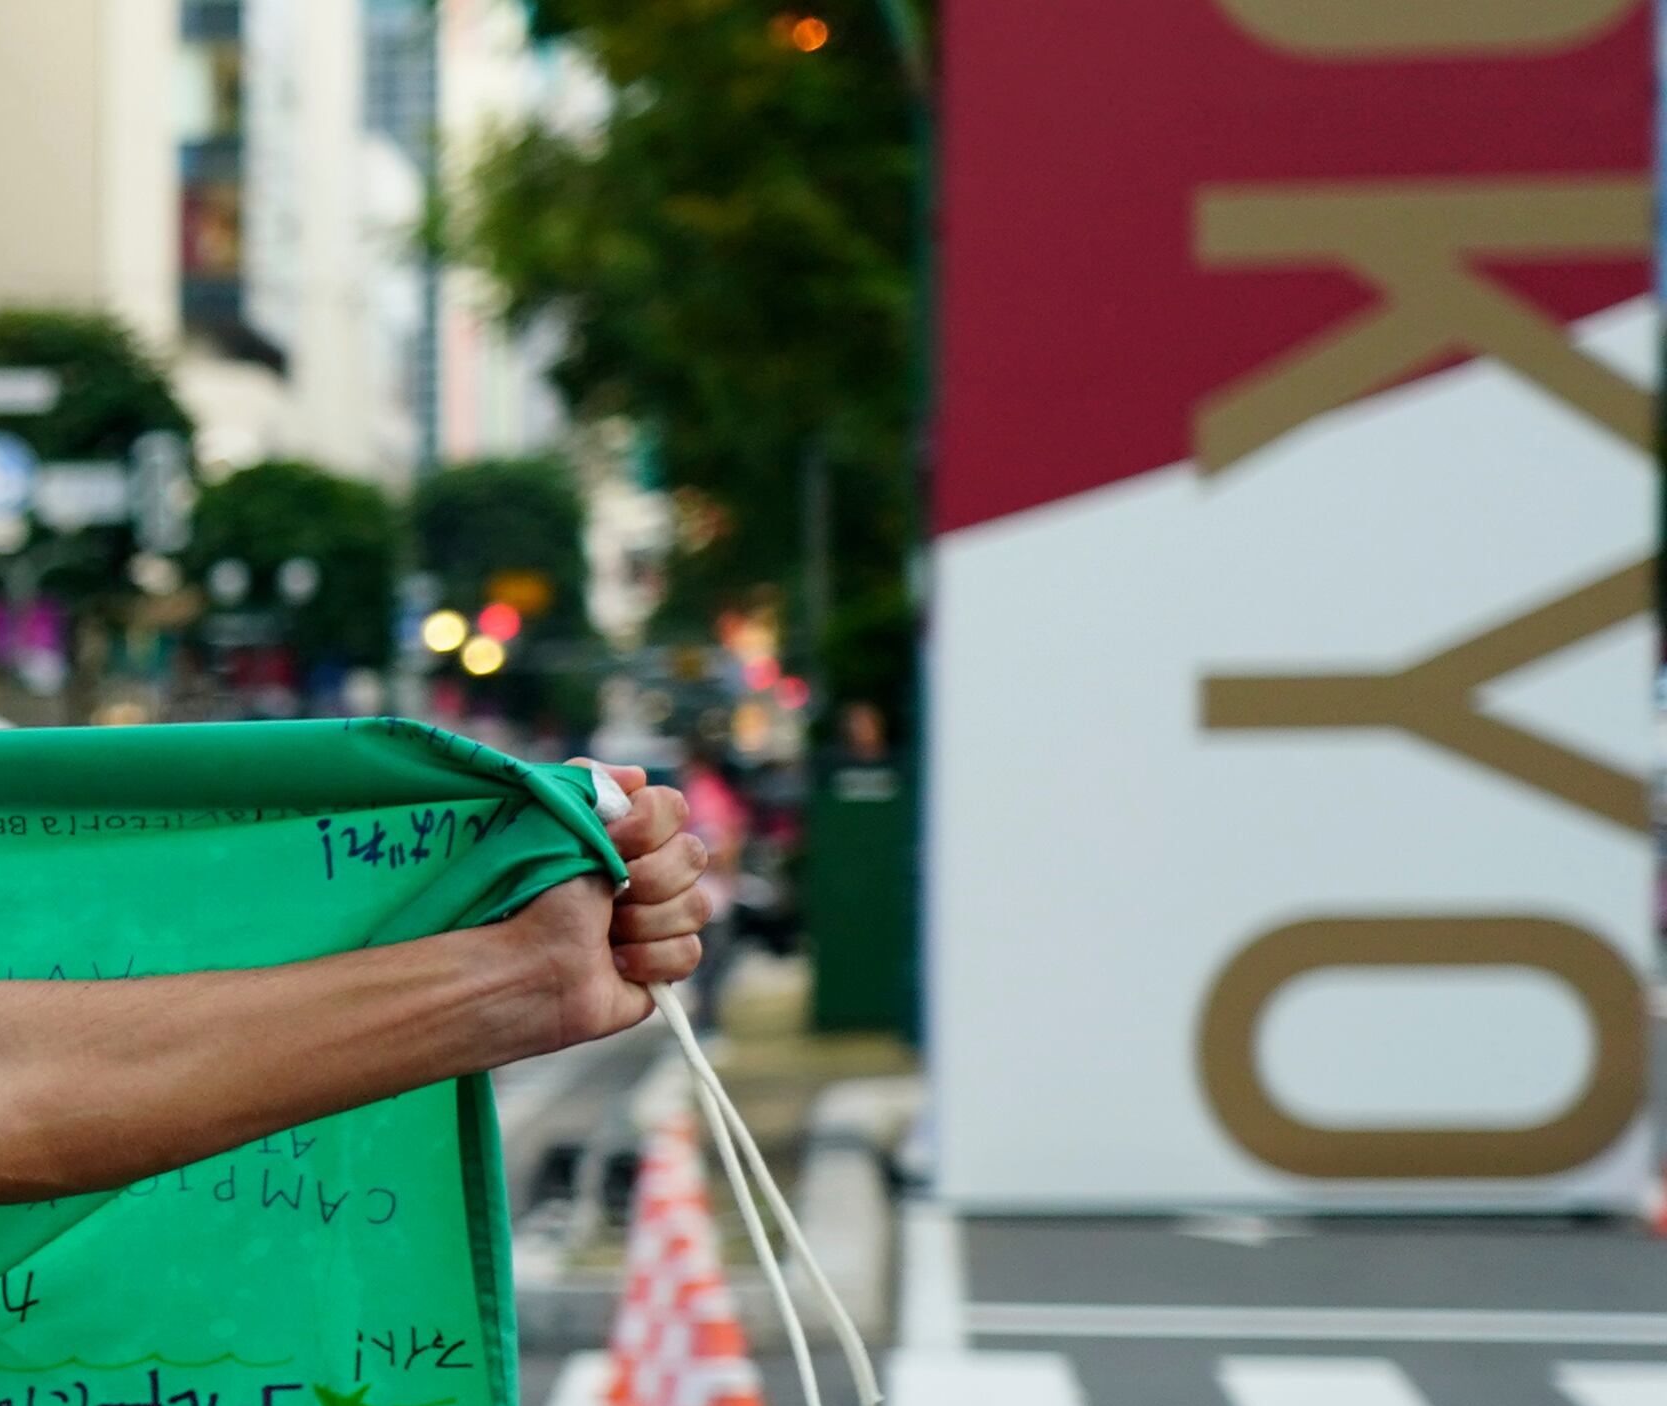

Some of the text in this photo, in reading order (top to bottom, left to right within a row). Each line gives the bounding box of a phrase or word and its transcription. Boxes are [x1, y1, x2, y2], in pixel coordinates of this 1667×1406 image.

[1189, 0, 1652, 1180] KYO
[353, 1327, 473, 1381] ファイト!
